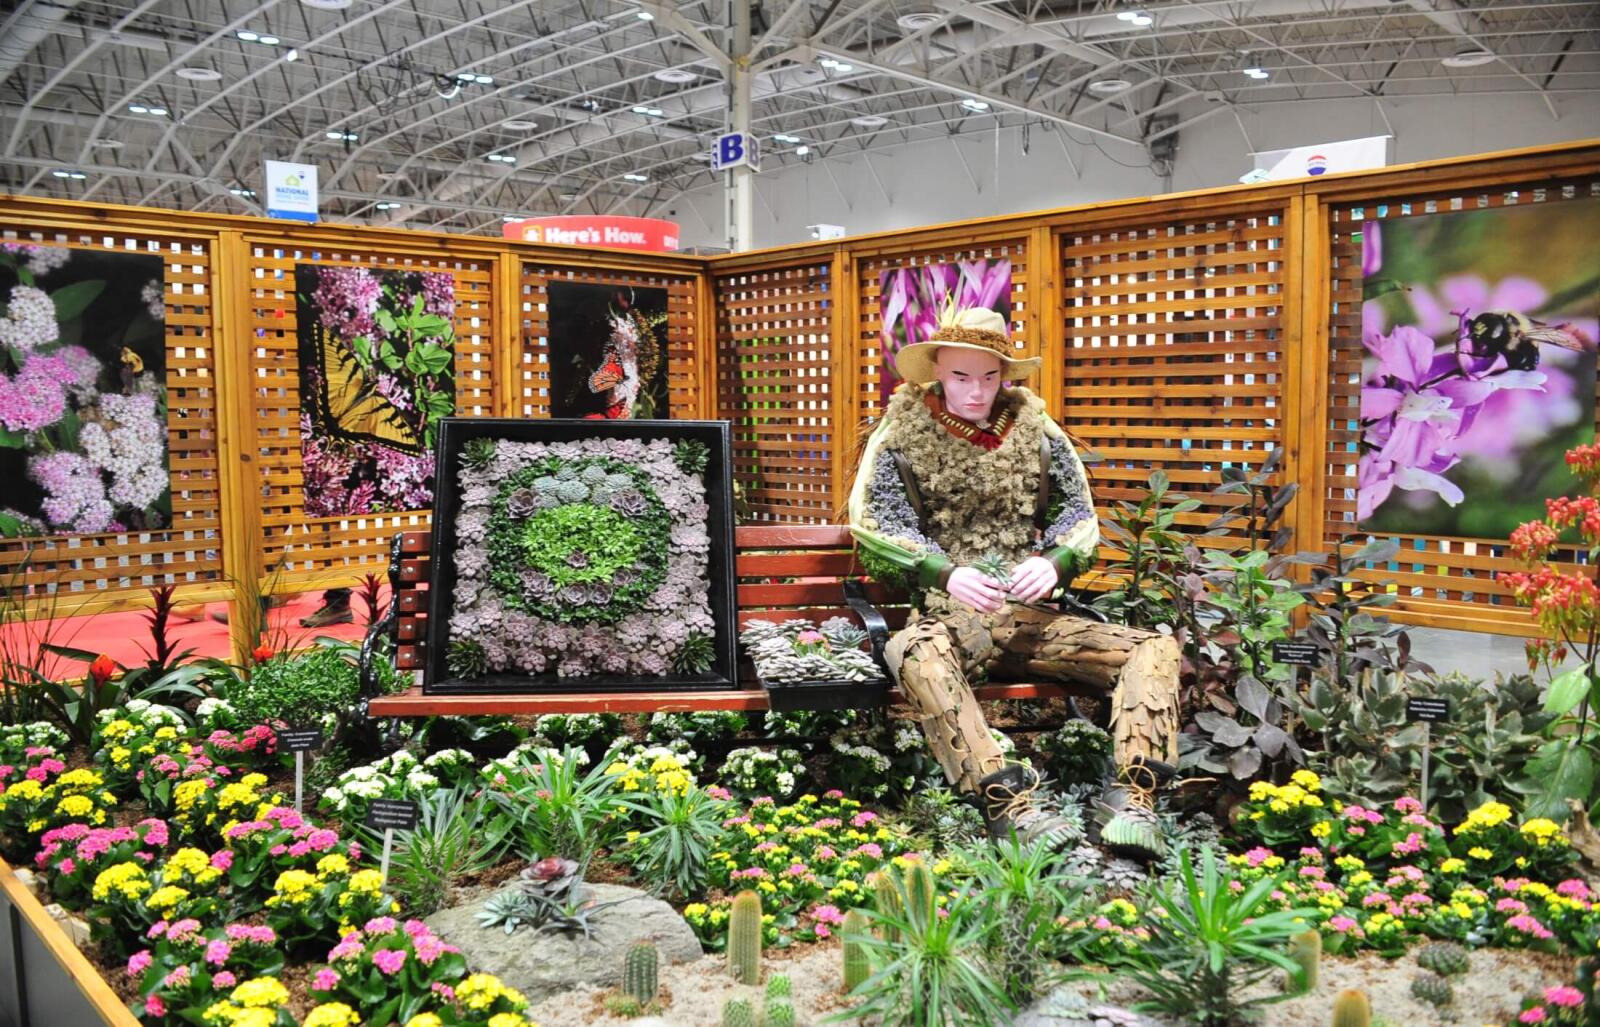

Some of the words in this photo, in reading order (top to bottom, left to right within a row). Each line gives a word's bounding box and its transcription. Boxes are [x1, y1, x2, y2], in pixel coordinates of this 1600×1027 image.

[720, 134, 744, 164] B
[545, 227, 600, 245] Here's
[604, 227, 646, 244] How.
